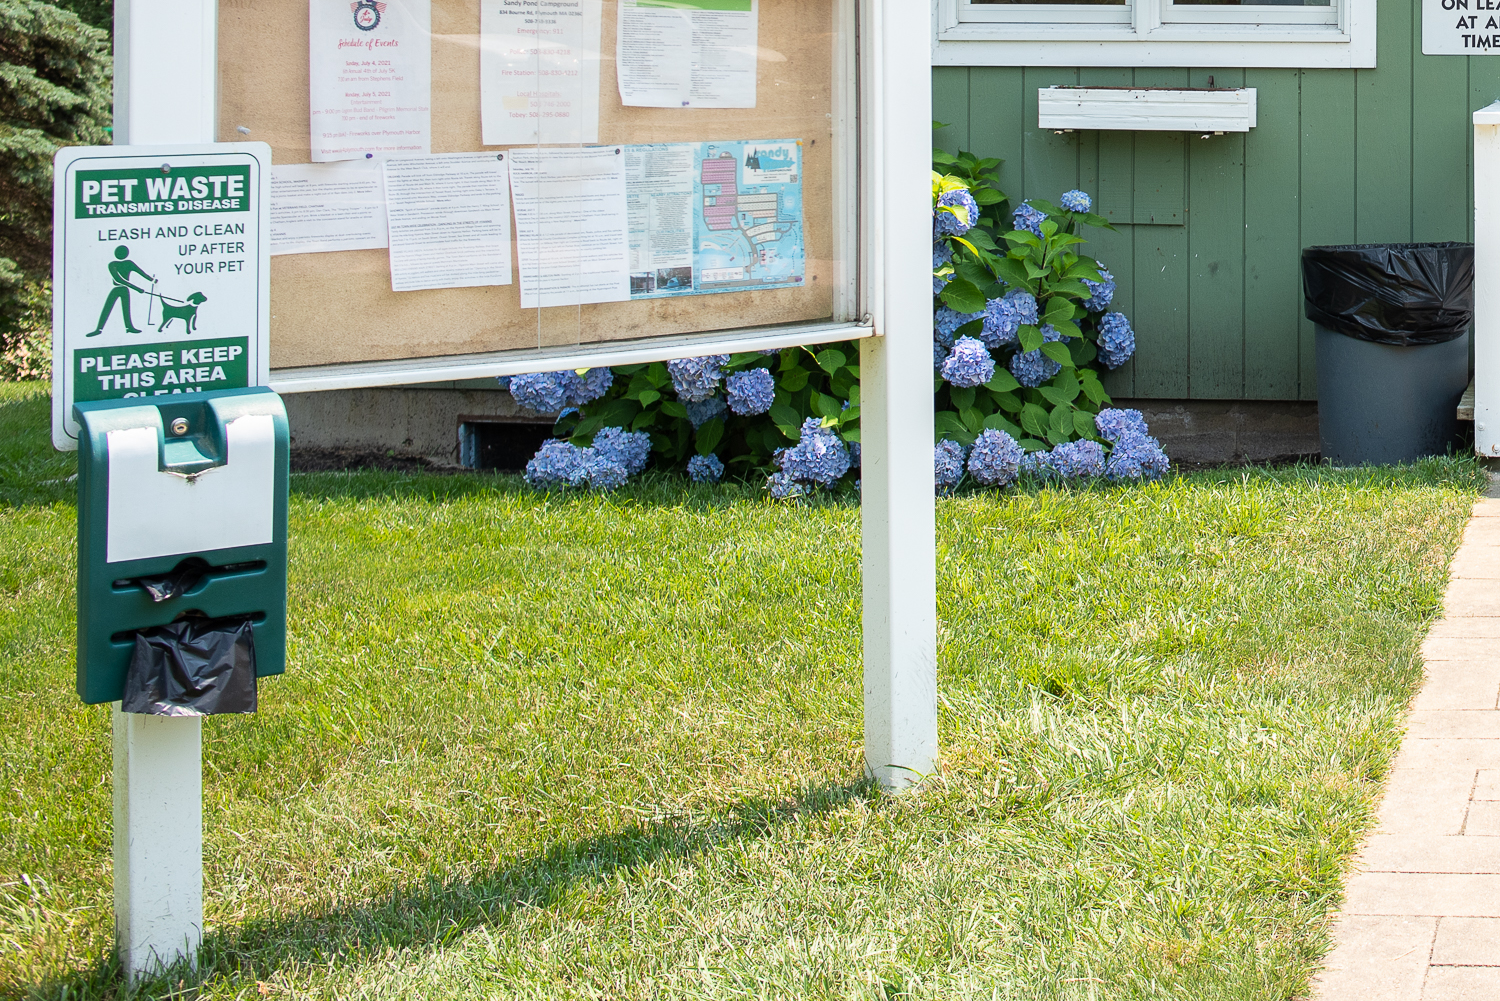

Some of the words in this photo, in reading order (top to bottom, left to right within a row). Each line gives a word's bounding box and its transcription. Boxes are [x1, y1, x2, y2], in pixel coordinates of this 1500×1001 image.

[1456, 16, 1478, 29] AT
[338, 39, 363, 50] Schedule
[365, 39, 374, 50] of
[375, 39, 398, 47] Events
[82, 178, 138, 204] PET
[146, 175, 244, 201] WASTE
[86, 201, 174, 215] TRANSMITS
[178, 198, 240, 211] DISEASE
[98, 228, 151, 242] LEASH
[156, 226, 188, 238] AND
[194, 223, 245, 238] CLEAN
[178, 244, 197, 256] UP
[200, 242, 245, 255] AFTER
[174, 262, 214, 275] YOUR
[218, 260, 245, 272] PET
[80, 351, 174, 373] PLEASE
[180, 346, 242, 365] KEEP
[98, 372, 156, 391] THIS
[162, 366, 226, 386] AREA
